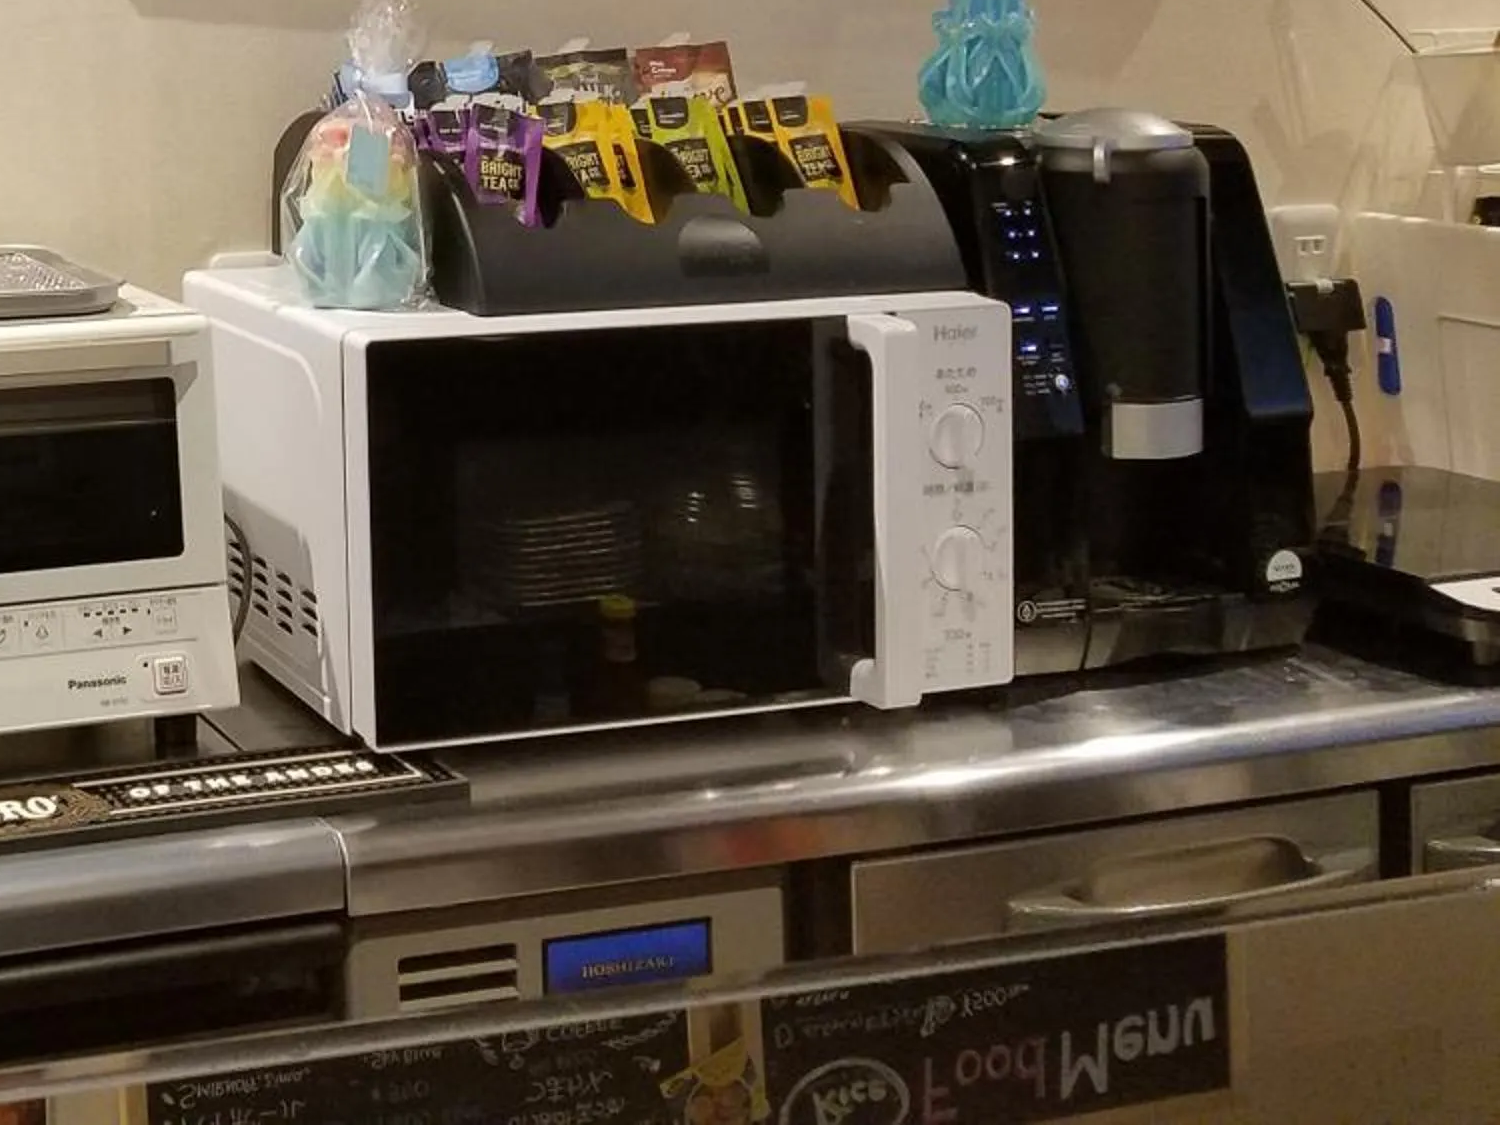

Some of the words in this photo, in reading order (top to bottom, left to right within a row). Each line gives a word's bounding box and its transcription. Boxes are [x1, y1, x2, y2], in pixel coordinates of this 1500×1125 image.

[480, 159, 523, 179] BRIGHT
[481, 177, 508, 191] TEA
[67, 675, 128, 690] Panasonic
[581, 954, 676, 979] HOSHIZAKI
